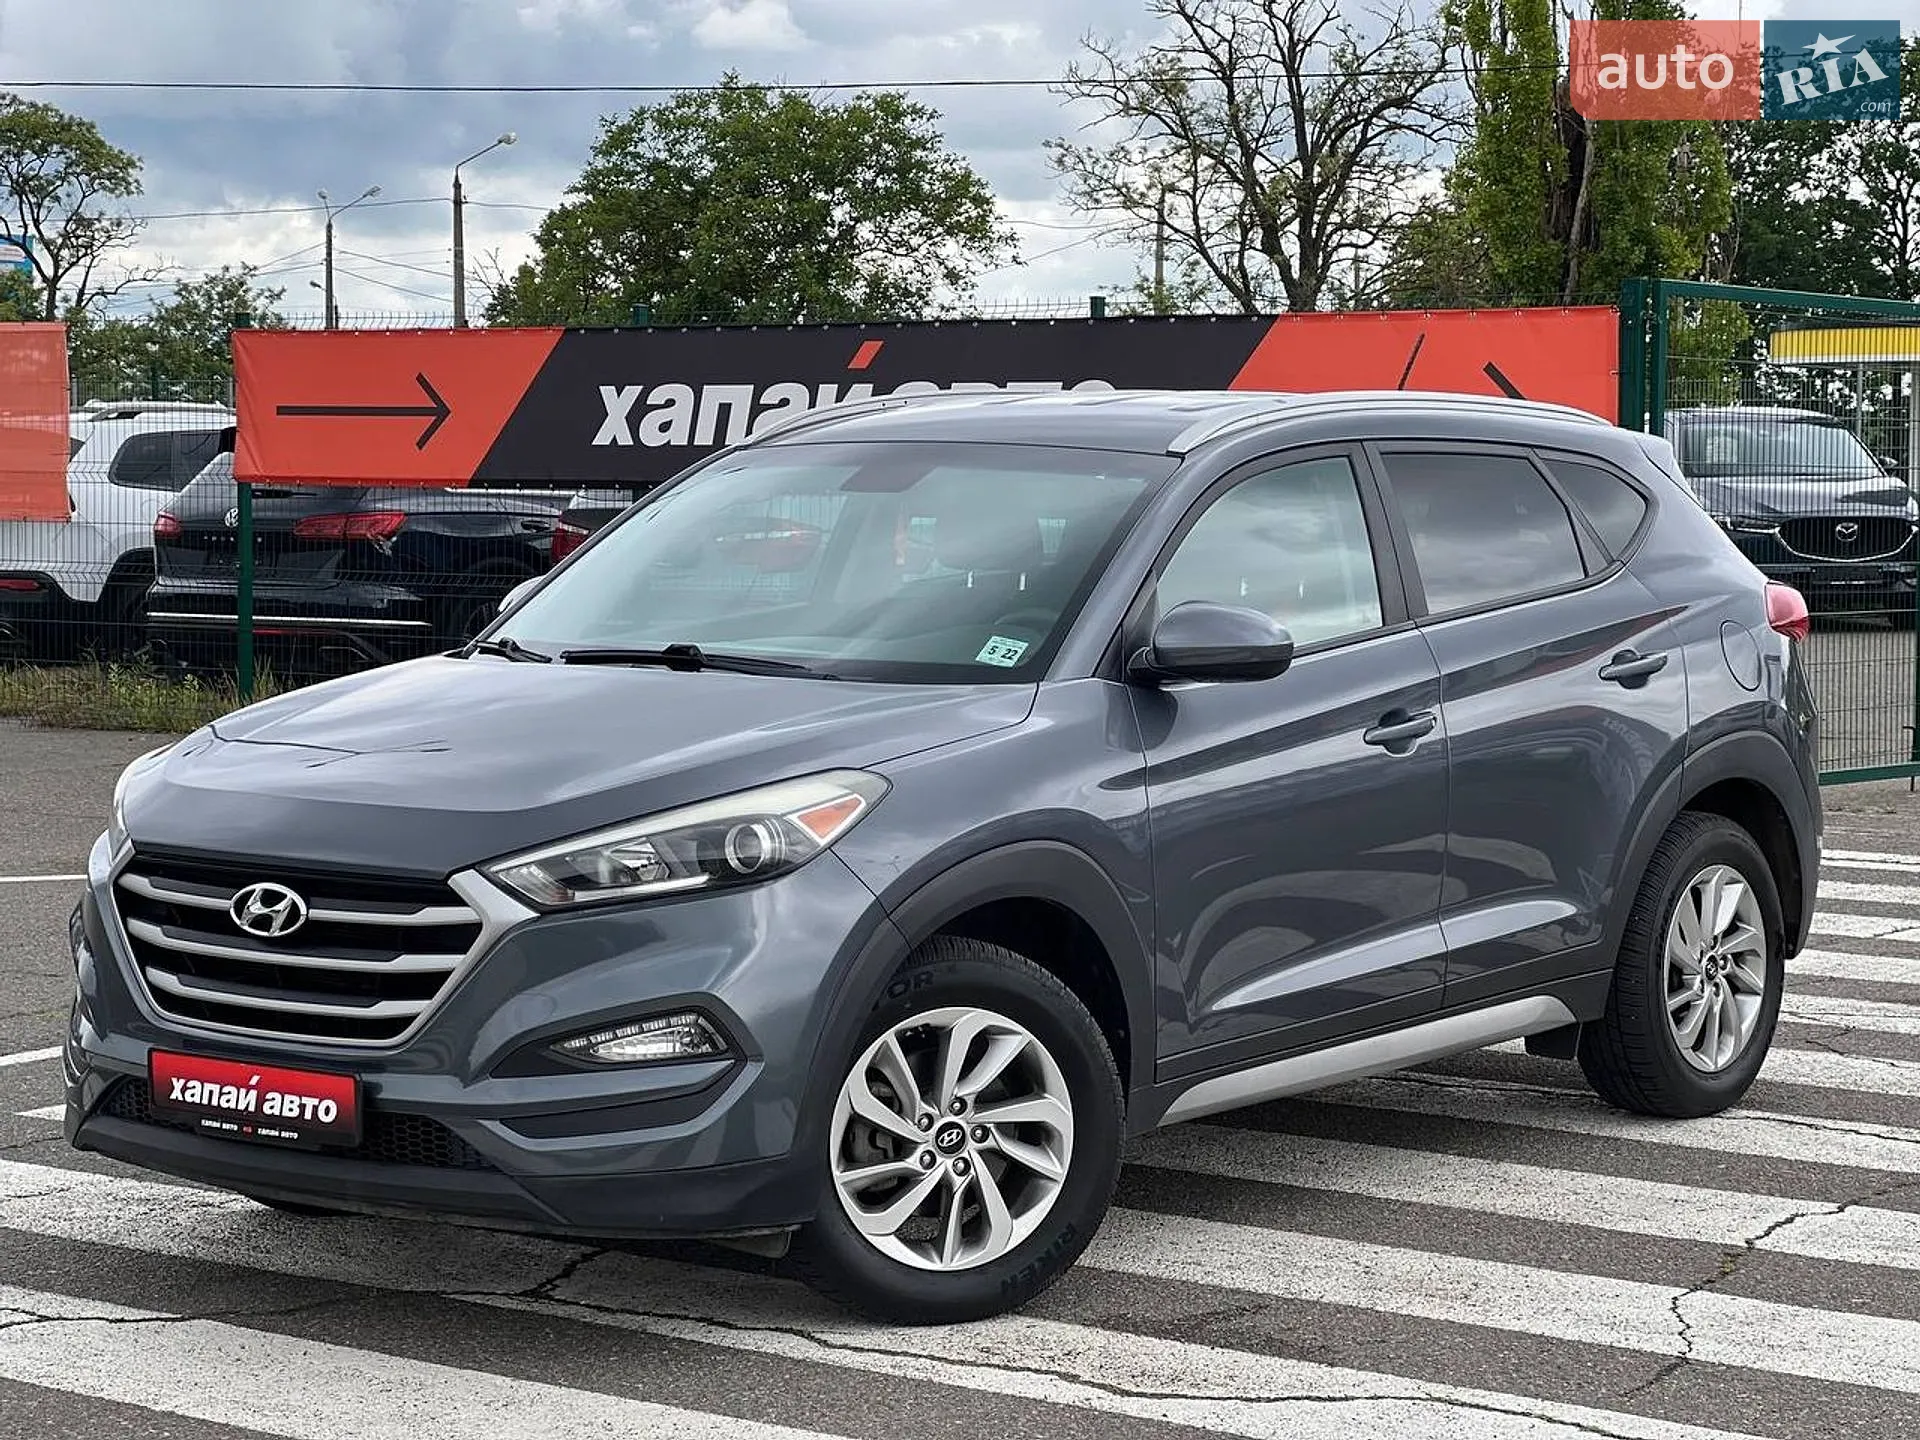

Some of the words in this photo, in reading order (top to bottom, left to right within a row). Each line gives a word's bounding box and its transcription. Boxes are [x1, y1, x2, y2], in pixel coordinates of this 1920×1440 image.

[988, 645, 999, 655] 5
[1000, 648, 1018, 660] 22
[169, 1075, 261, 1112] хапай
[263, 1091, 338, 1124] авто
